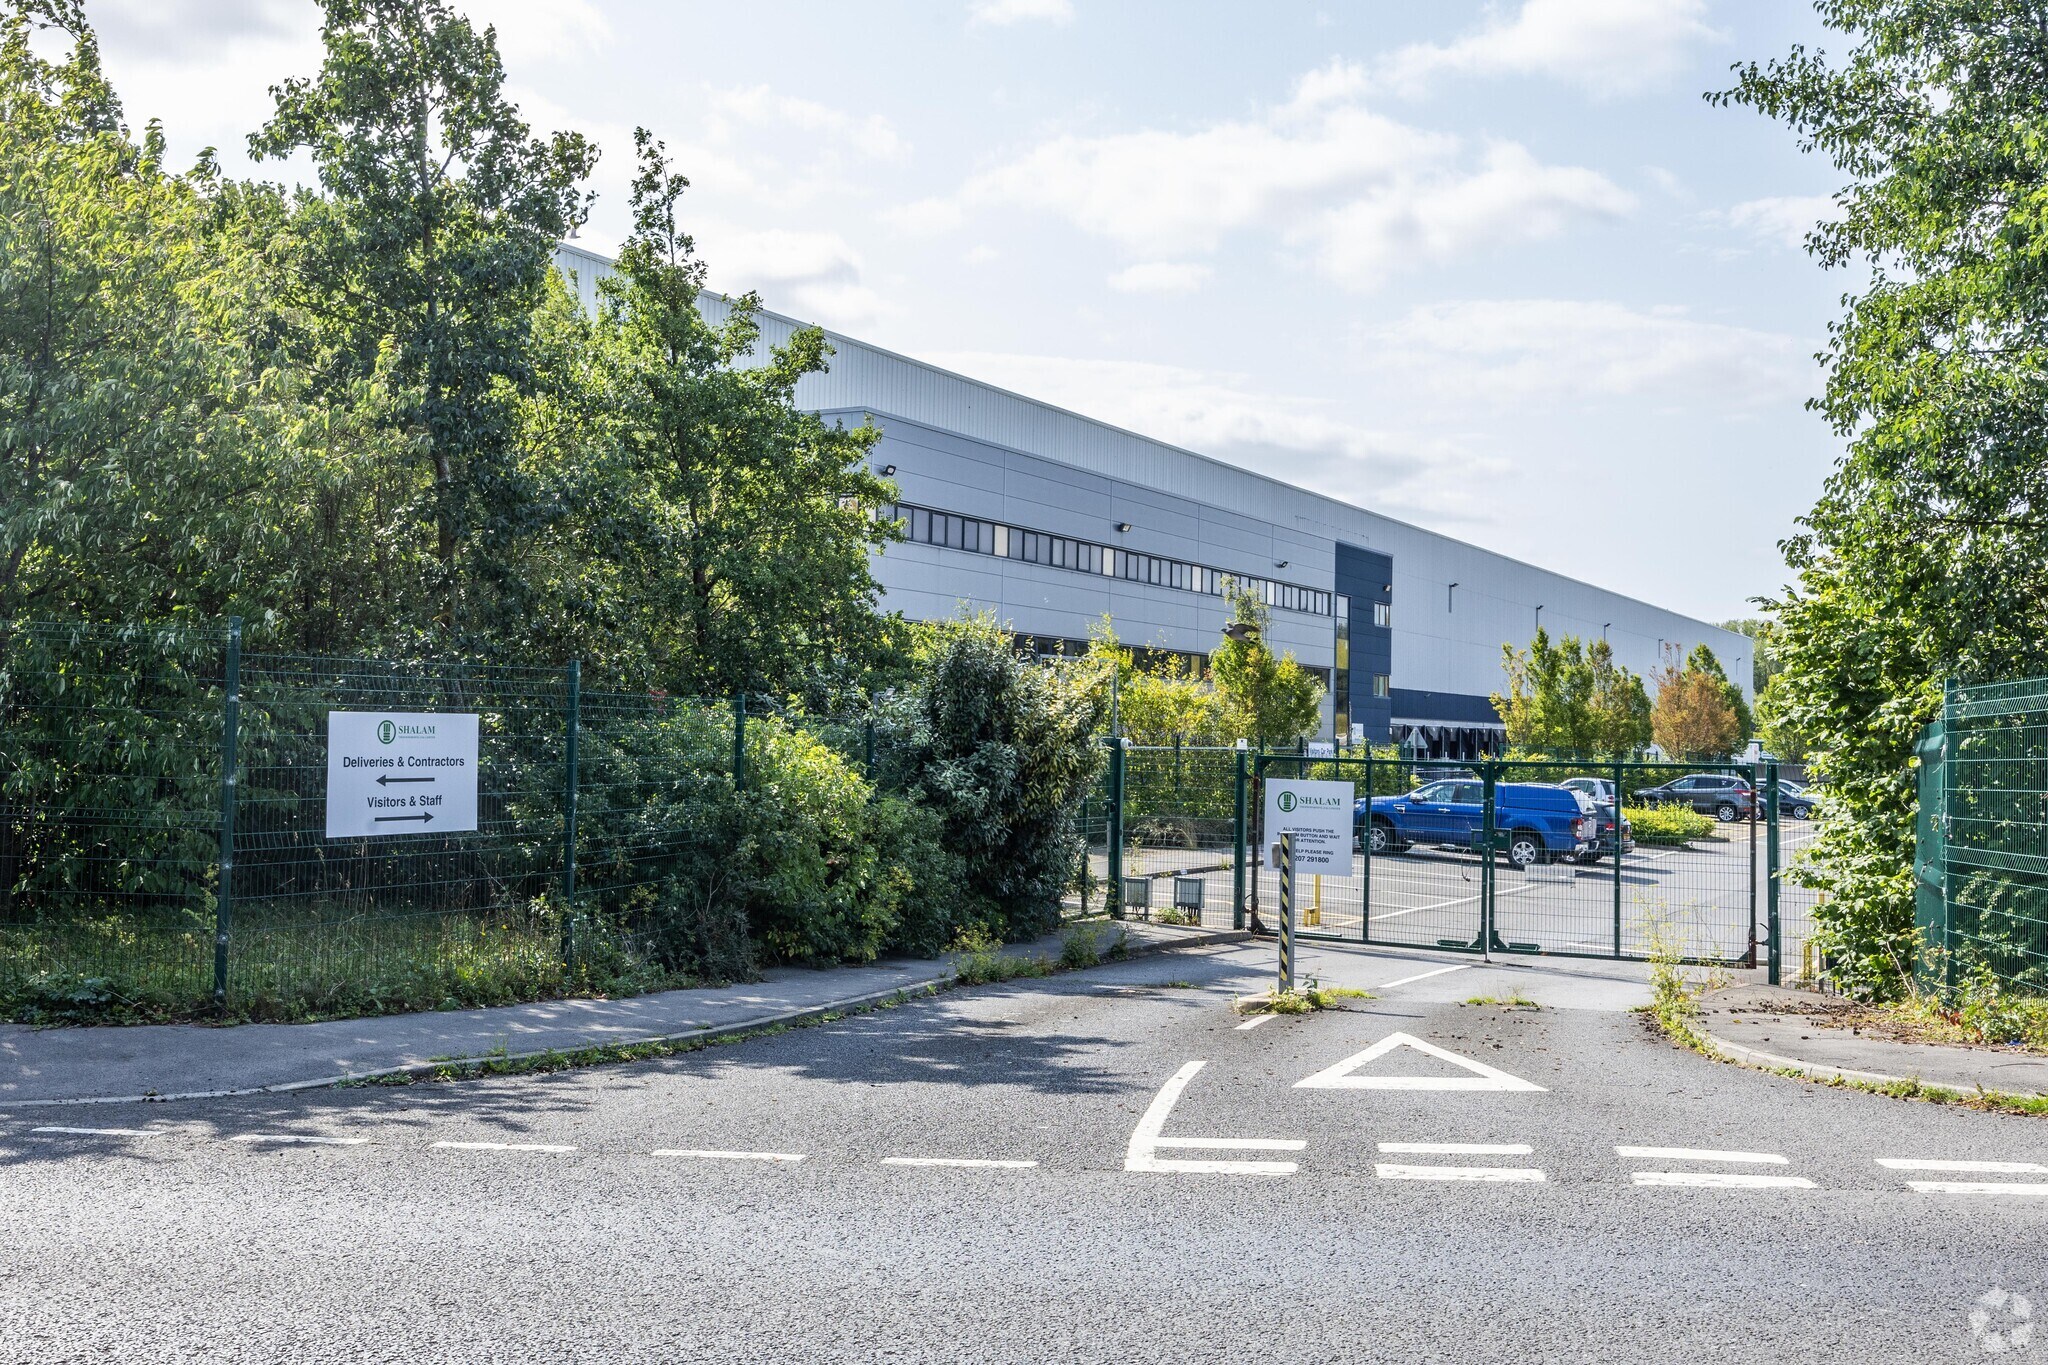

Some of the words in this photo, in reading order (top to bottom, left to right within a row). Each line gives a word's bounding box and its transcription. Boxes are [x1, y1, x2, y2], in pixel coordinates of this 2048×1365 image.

[398, 725, 436, 735] SHALAM
[343, 756, 394, 768] Deliveries
[397, 756, 405, 767] &
[407, 756, 465, 767] Contractors
[367, 796, 406, 808] Visitors
[409, 796, 416, 807] &
[419, 795, 442, 806] Staff
[1299, 796, 1341, 806] SHALAM
